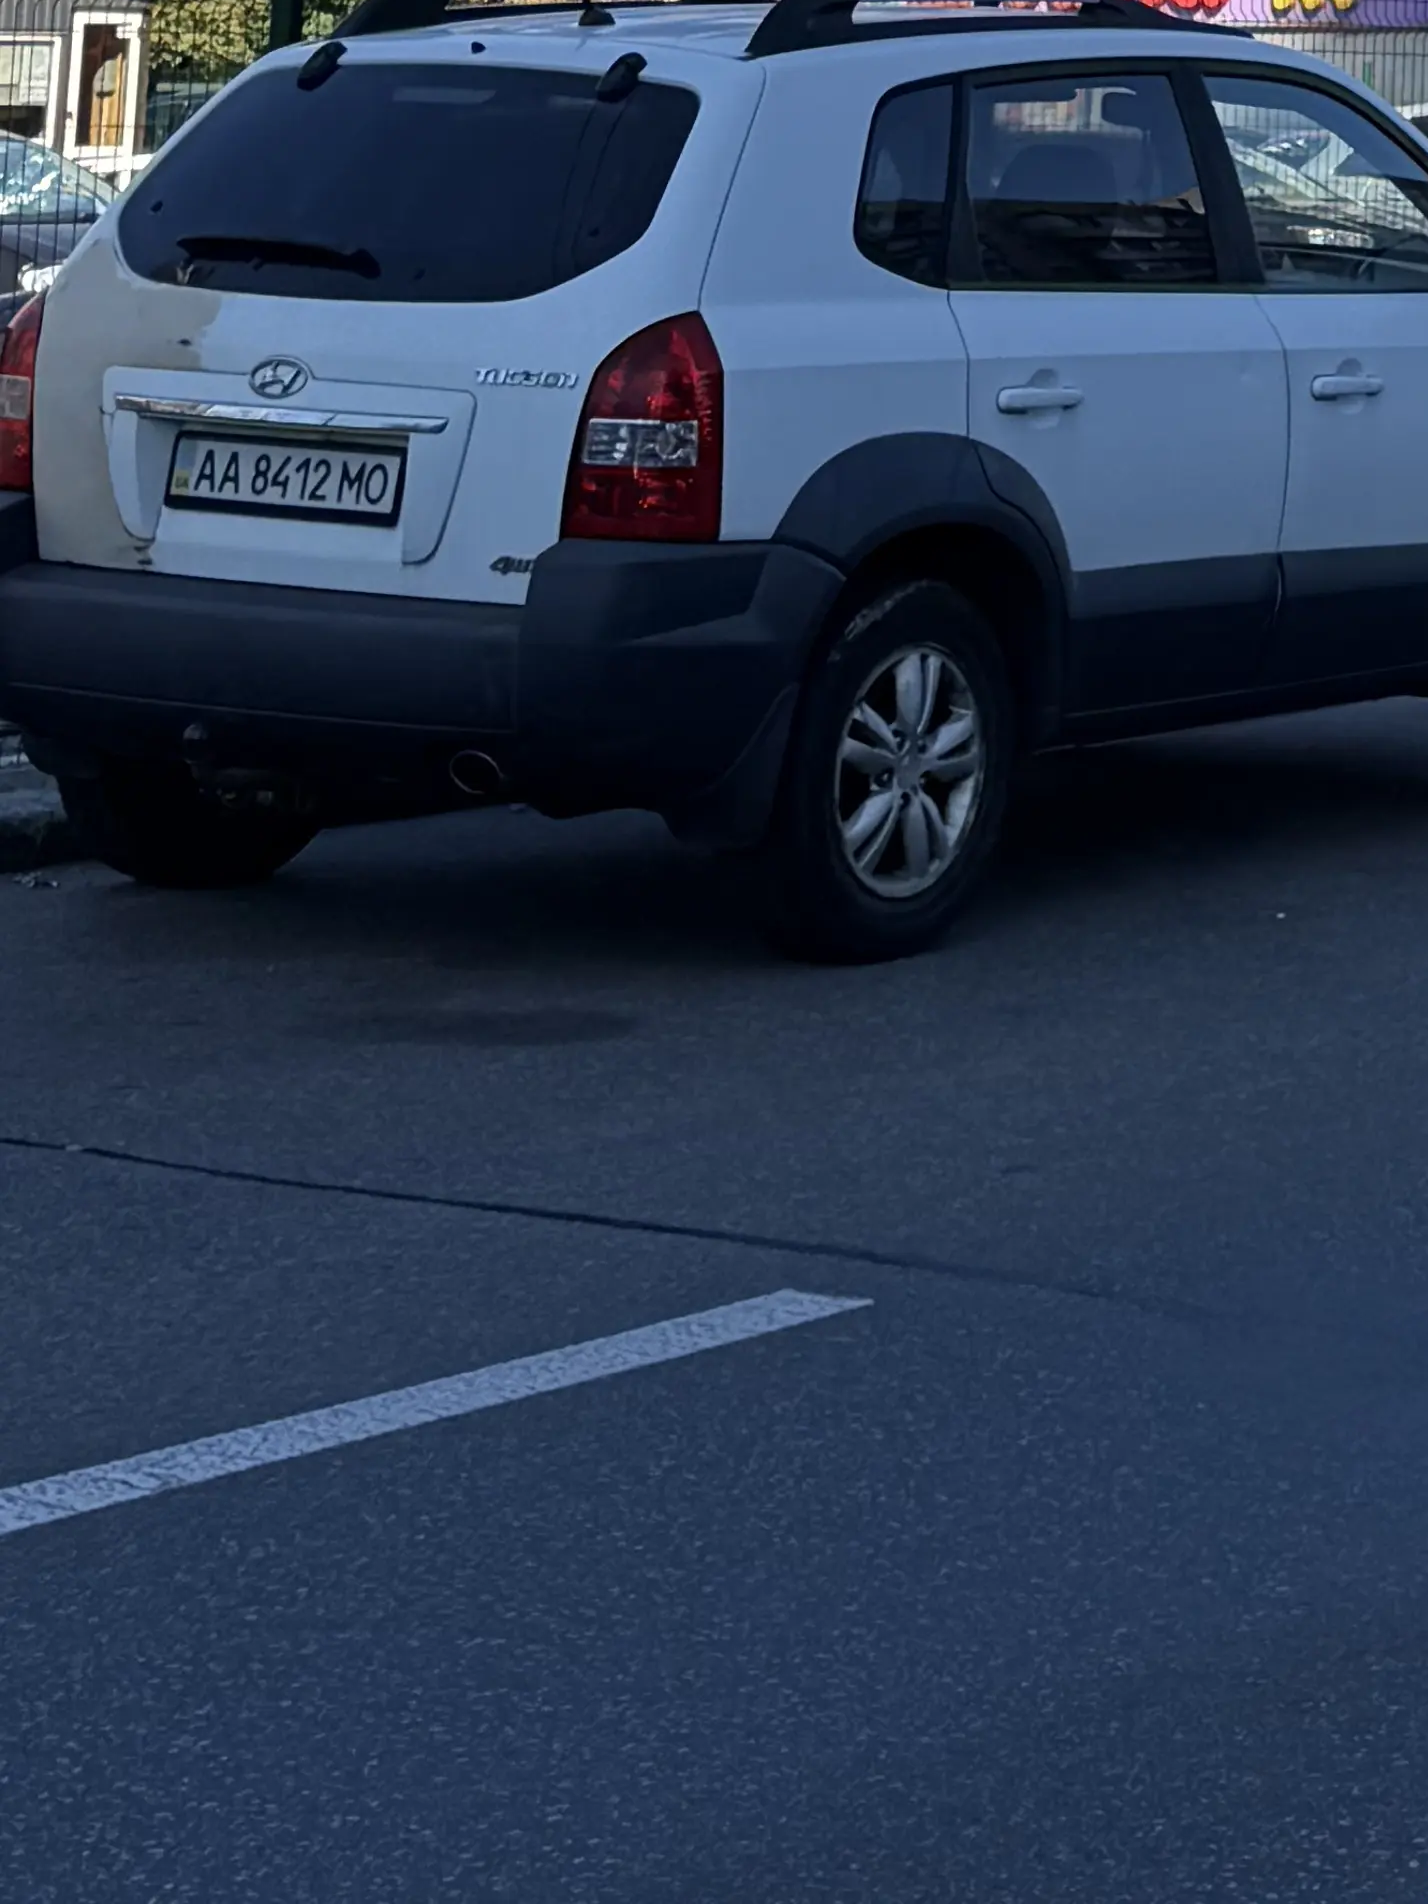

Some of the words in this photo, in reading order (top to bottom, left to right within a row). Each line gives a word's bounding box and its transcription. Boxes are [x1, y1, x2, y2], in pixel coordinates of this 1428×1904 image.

[193, 448, 239, 494] AA
[251, 453, 331, 501] 8412
[337, 460, 389, 505] MO
